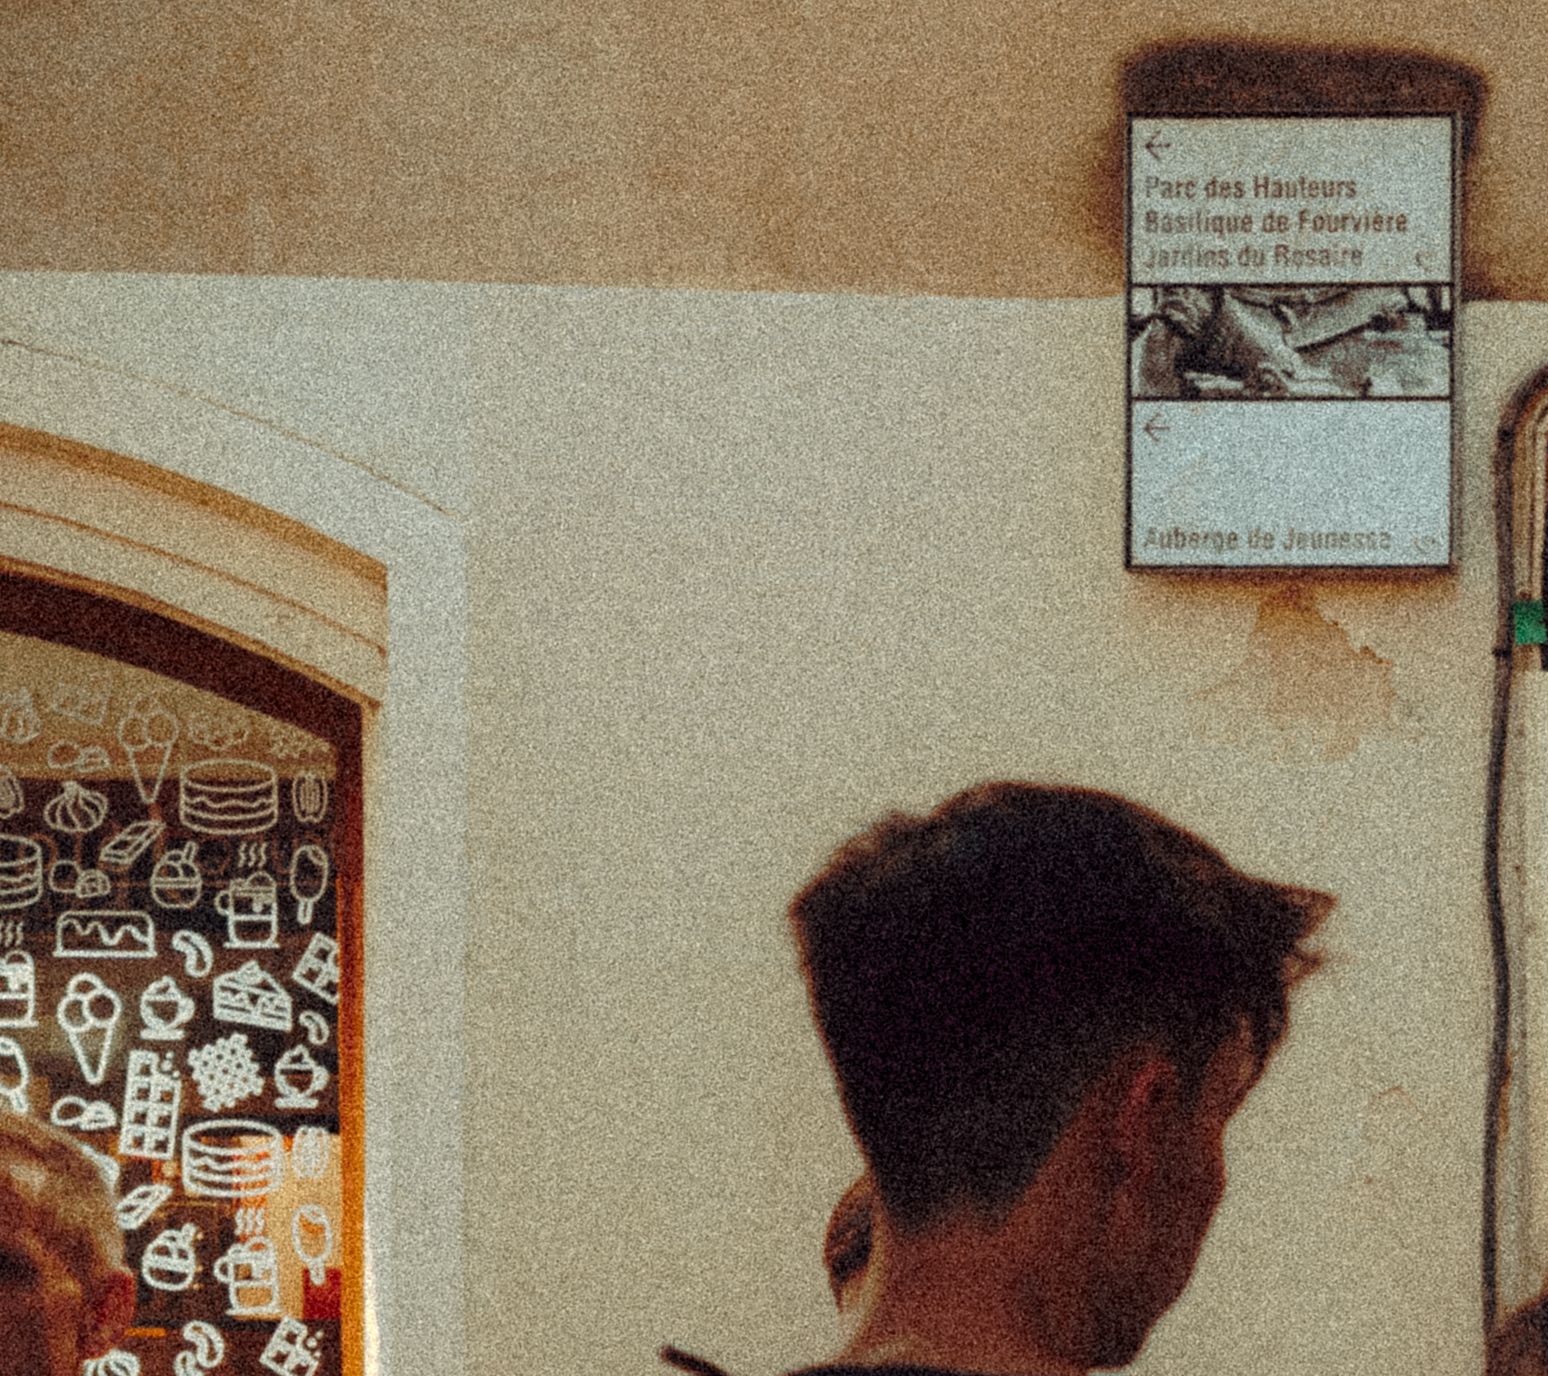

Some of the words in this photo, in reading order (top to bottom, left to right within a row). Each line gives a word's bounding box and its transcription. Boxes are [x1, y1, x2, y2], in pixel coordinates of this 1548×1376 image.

[1145, 175, 1197, 200] Parc
[1204, 175, 1246, 200] des
[1252, 175, 1358, 200] Hauteurs
[1145, 210, 1252, 239] Basilique
[1261, 210, 1290, 233] de
[1300, 209, 1408, 234] Fourvière
[1145, 245, 1230, 270] Jardins
[1238, 244, 1266, 267] du
[1274, 244, 1364, 267] Rosaire
[1144, 527, 1239, 553] Auberge
[1248, 527, 1275, 550] de
[1283, 527, 1392, 551] Jeunesse
